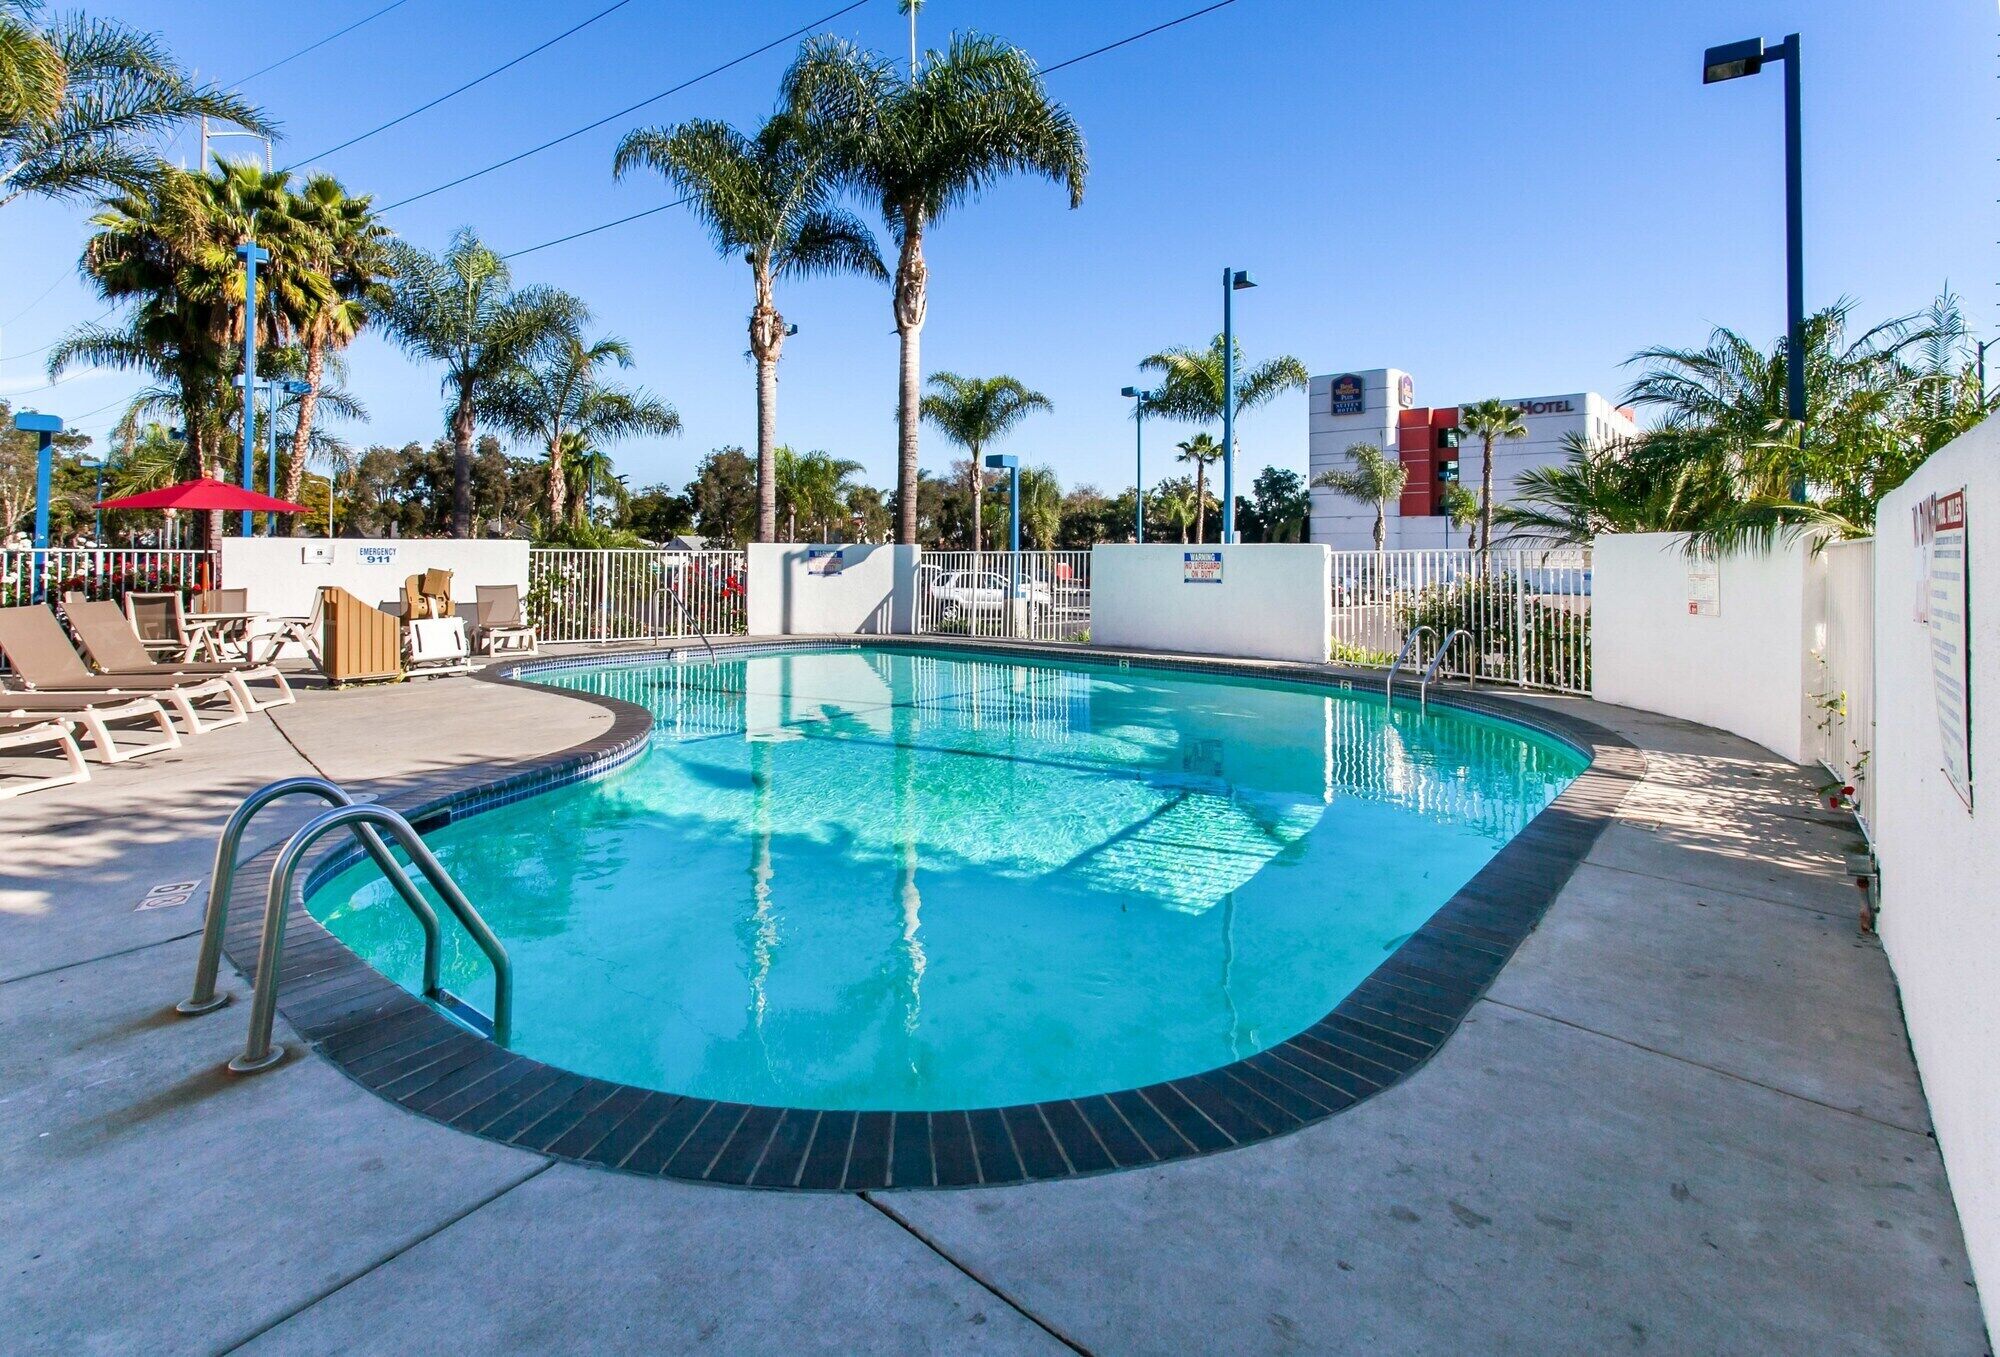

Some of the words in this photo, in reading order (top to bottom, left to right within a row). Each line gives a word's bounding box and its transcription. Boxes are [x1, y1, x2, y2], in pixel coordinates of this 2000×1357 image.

[1519, 400, 1575, 415] HOTEL
[359, 547, 397, 556] EMERGENCY
[1190, 553, 1215, 561] WARNING
[1184, 562, 1192, 570] NO
[1194, 562, 1220, 570] LIFEGUARD
[1191, 570, 1199, 578] ON
[1201, 570, 1214, 578] DUTY
